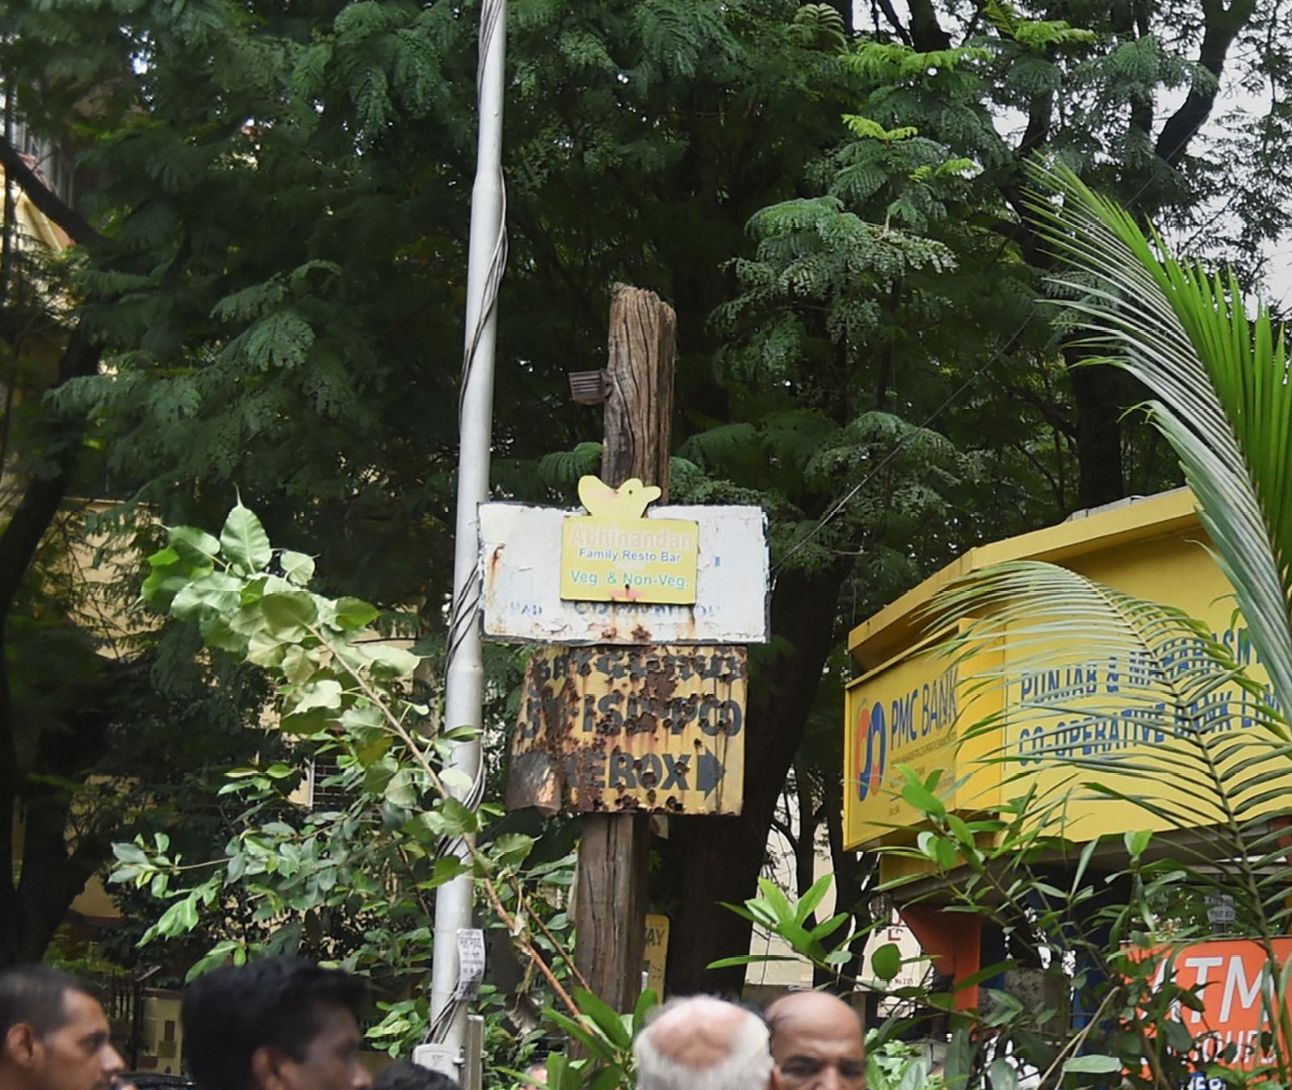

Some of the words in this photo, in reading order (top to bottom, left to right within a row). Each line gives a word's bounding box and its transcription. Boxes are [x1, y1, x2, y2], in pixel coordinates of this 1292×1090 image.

[578, 548, 618, 562] Family
[622, 550, 657, 562] Resto
[660, 551, 681, 563] Bar
[607, 572, 617, 585] &
[890, 688, 919, 751] PMC
[921, 667, 960, 737] BANK
